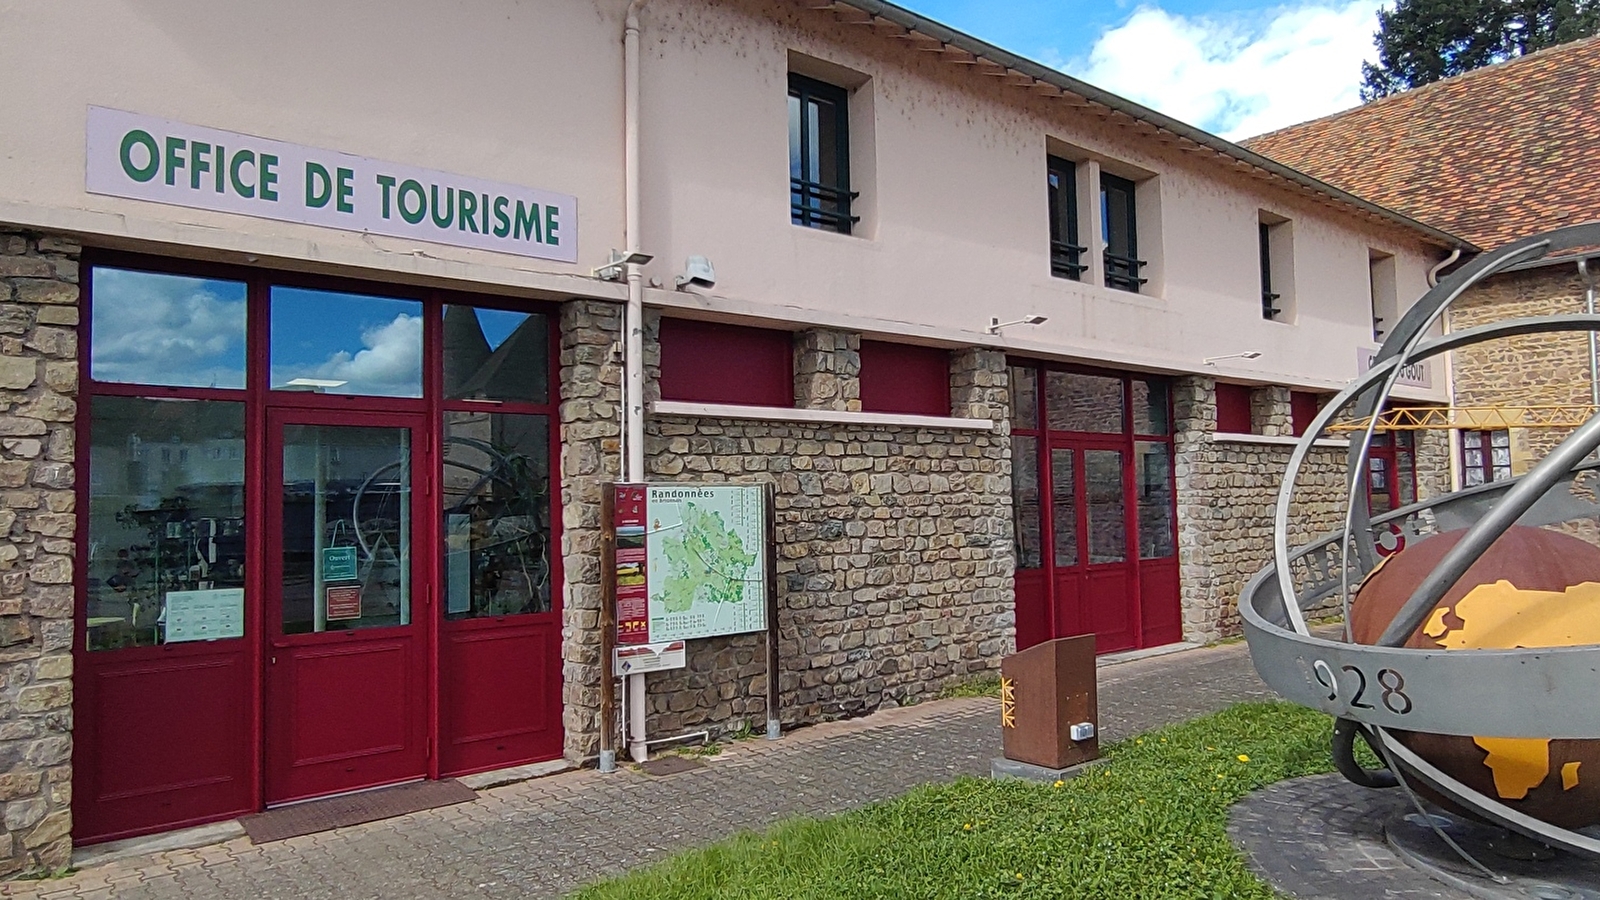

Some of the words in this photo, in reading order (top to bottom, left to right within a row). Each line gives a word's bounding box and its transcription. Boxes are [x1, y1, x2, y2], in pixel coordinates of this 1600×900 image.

[119, 128, 280, 203] OFFICE
[304, 160, 355, 215] DE
[376, 173, 561, 247] TOURISME
